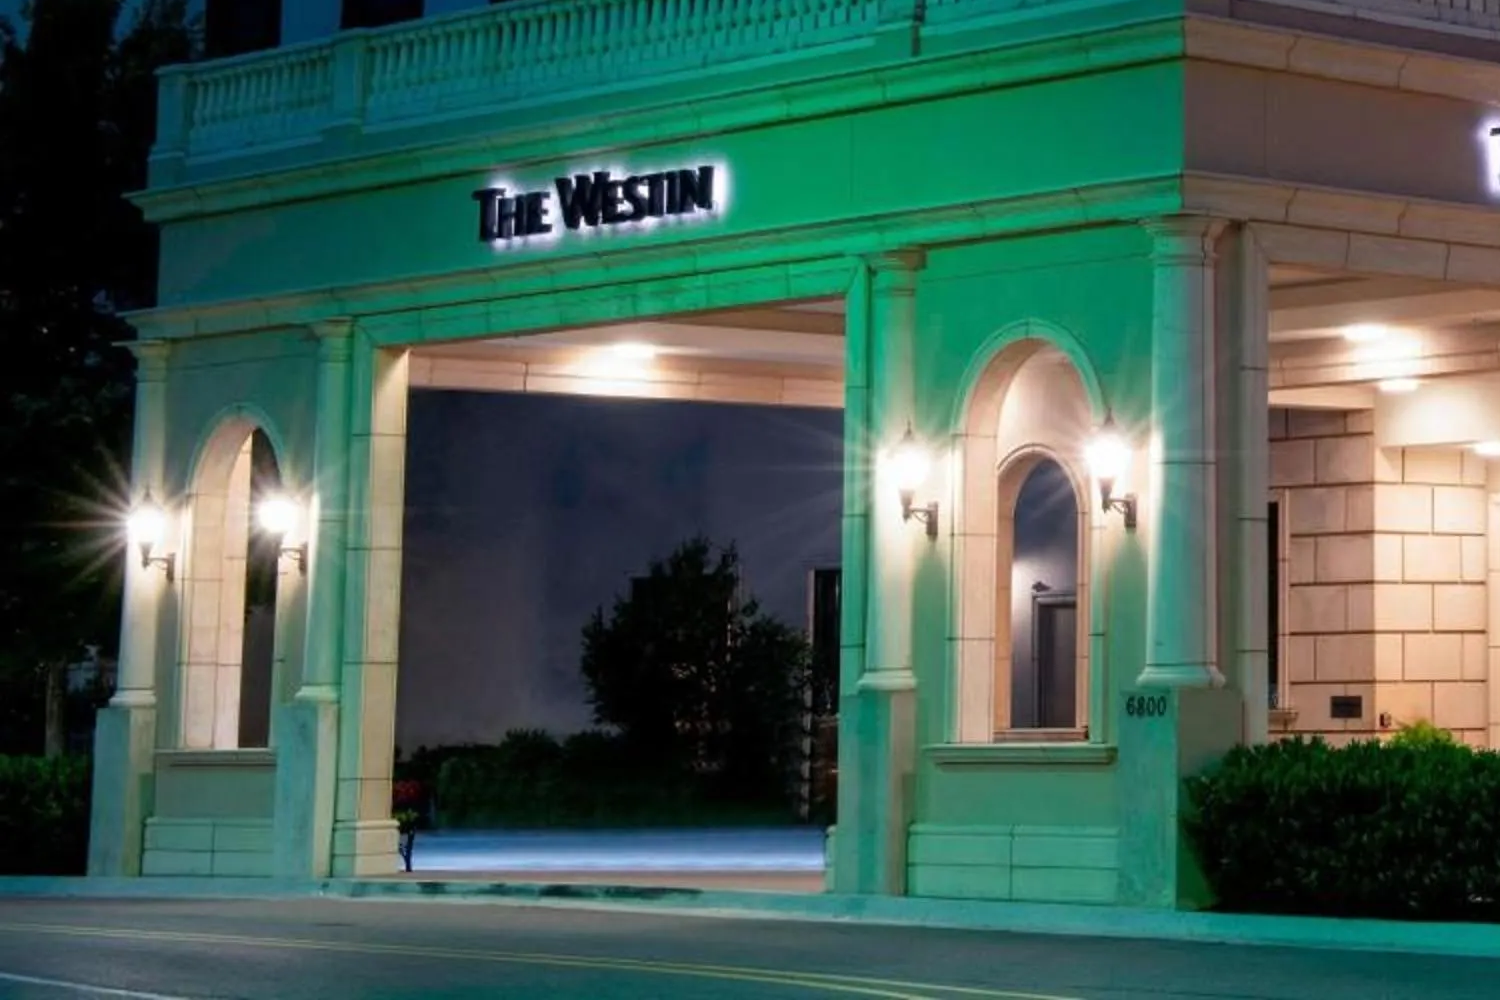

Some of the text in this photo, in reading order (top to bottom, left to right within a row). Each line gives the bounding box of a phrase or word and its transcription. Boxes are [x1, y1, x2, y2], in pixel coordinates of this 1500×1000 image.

[472, 165, 715, 242] THE WESTIN
[1126, 695, 1167, 718] 6800
